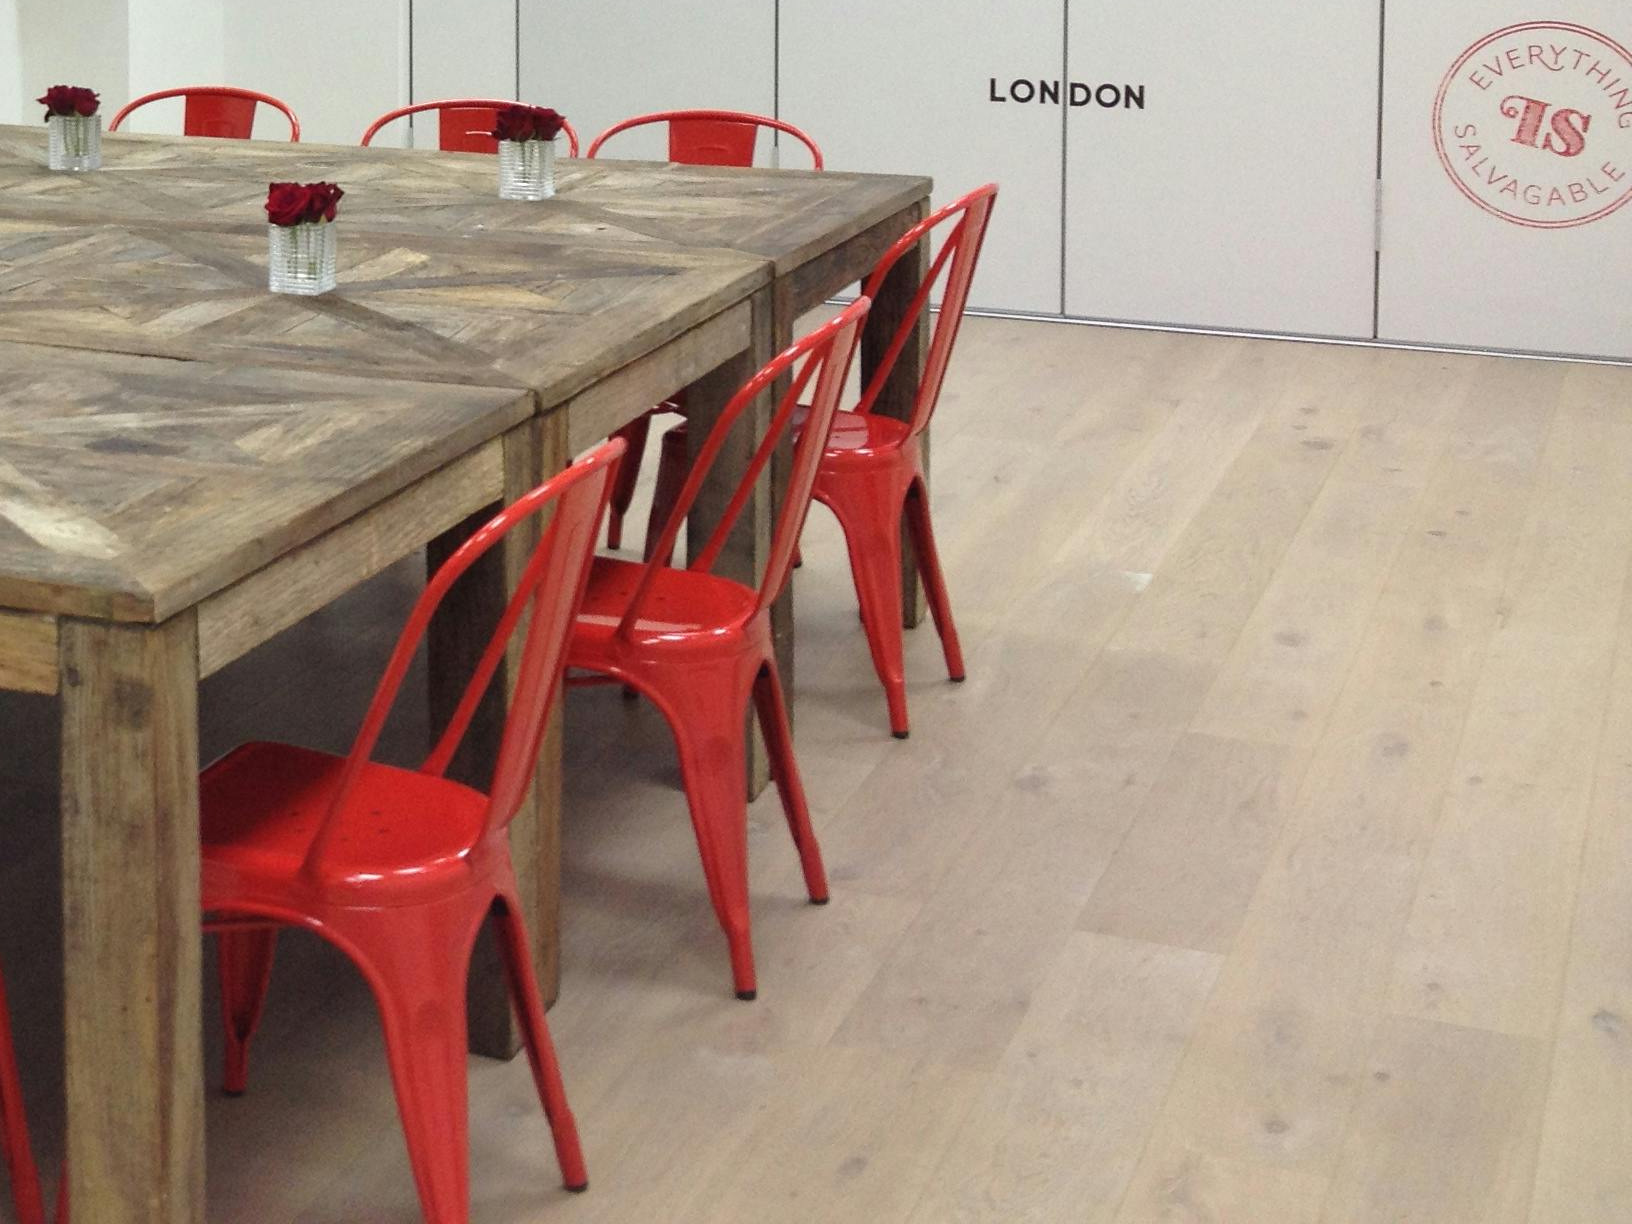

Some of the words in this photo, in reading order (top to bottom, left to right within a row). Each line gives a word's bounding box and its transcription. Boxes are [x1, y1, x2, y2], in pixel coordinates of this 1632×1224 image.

[989, 77, 1146, 110] LONDON
[1468, 44, 1632, 130] EVERYTHING
[1499, 94, 1593, 158] IS
[1454, 123, 1626, 207] SALVAGABLE
